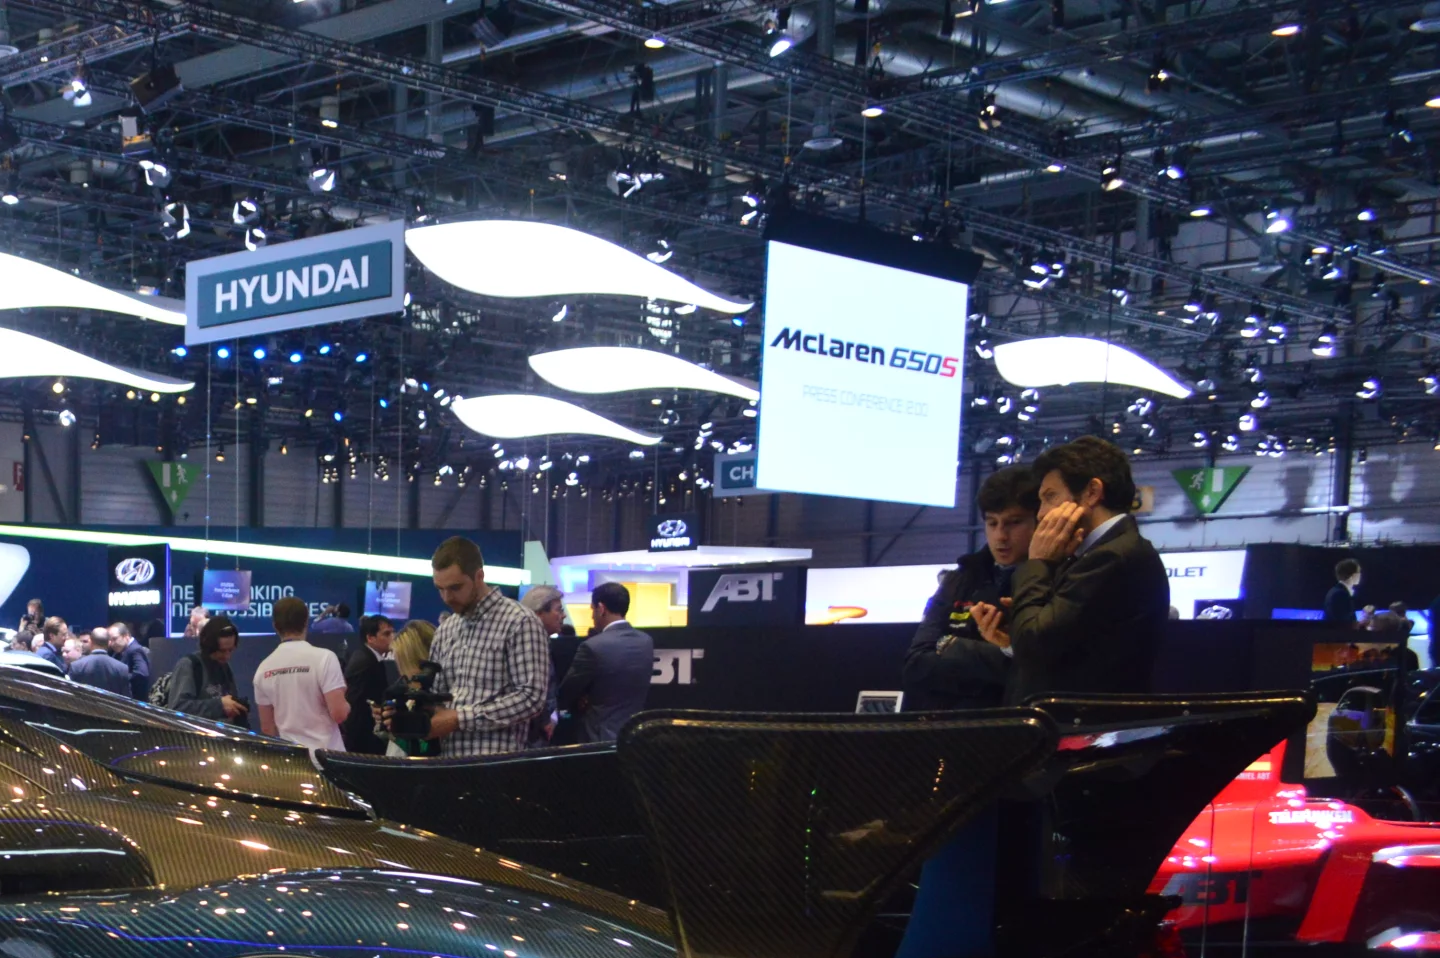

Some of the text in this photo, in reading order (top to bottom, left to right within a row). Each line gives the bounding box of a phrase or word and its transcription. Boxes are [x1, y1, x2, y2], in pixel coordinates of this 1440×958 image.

[215, 255, 370, 314] HYUNDAI
[770, 327, 959, 378] McLaren 650S
[651, 537, 690, 548] HYUNDAI
[700, 572, 784, 612] ABT
[650, 648, 705, 684] BT
